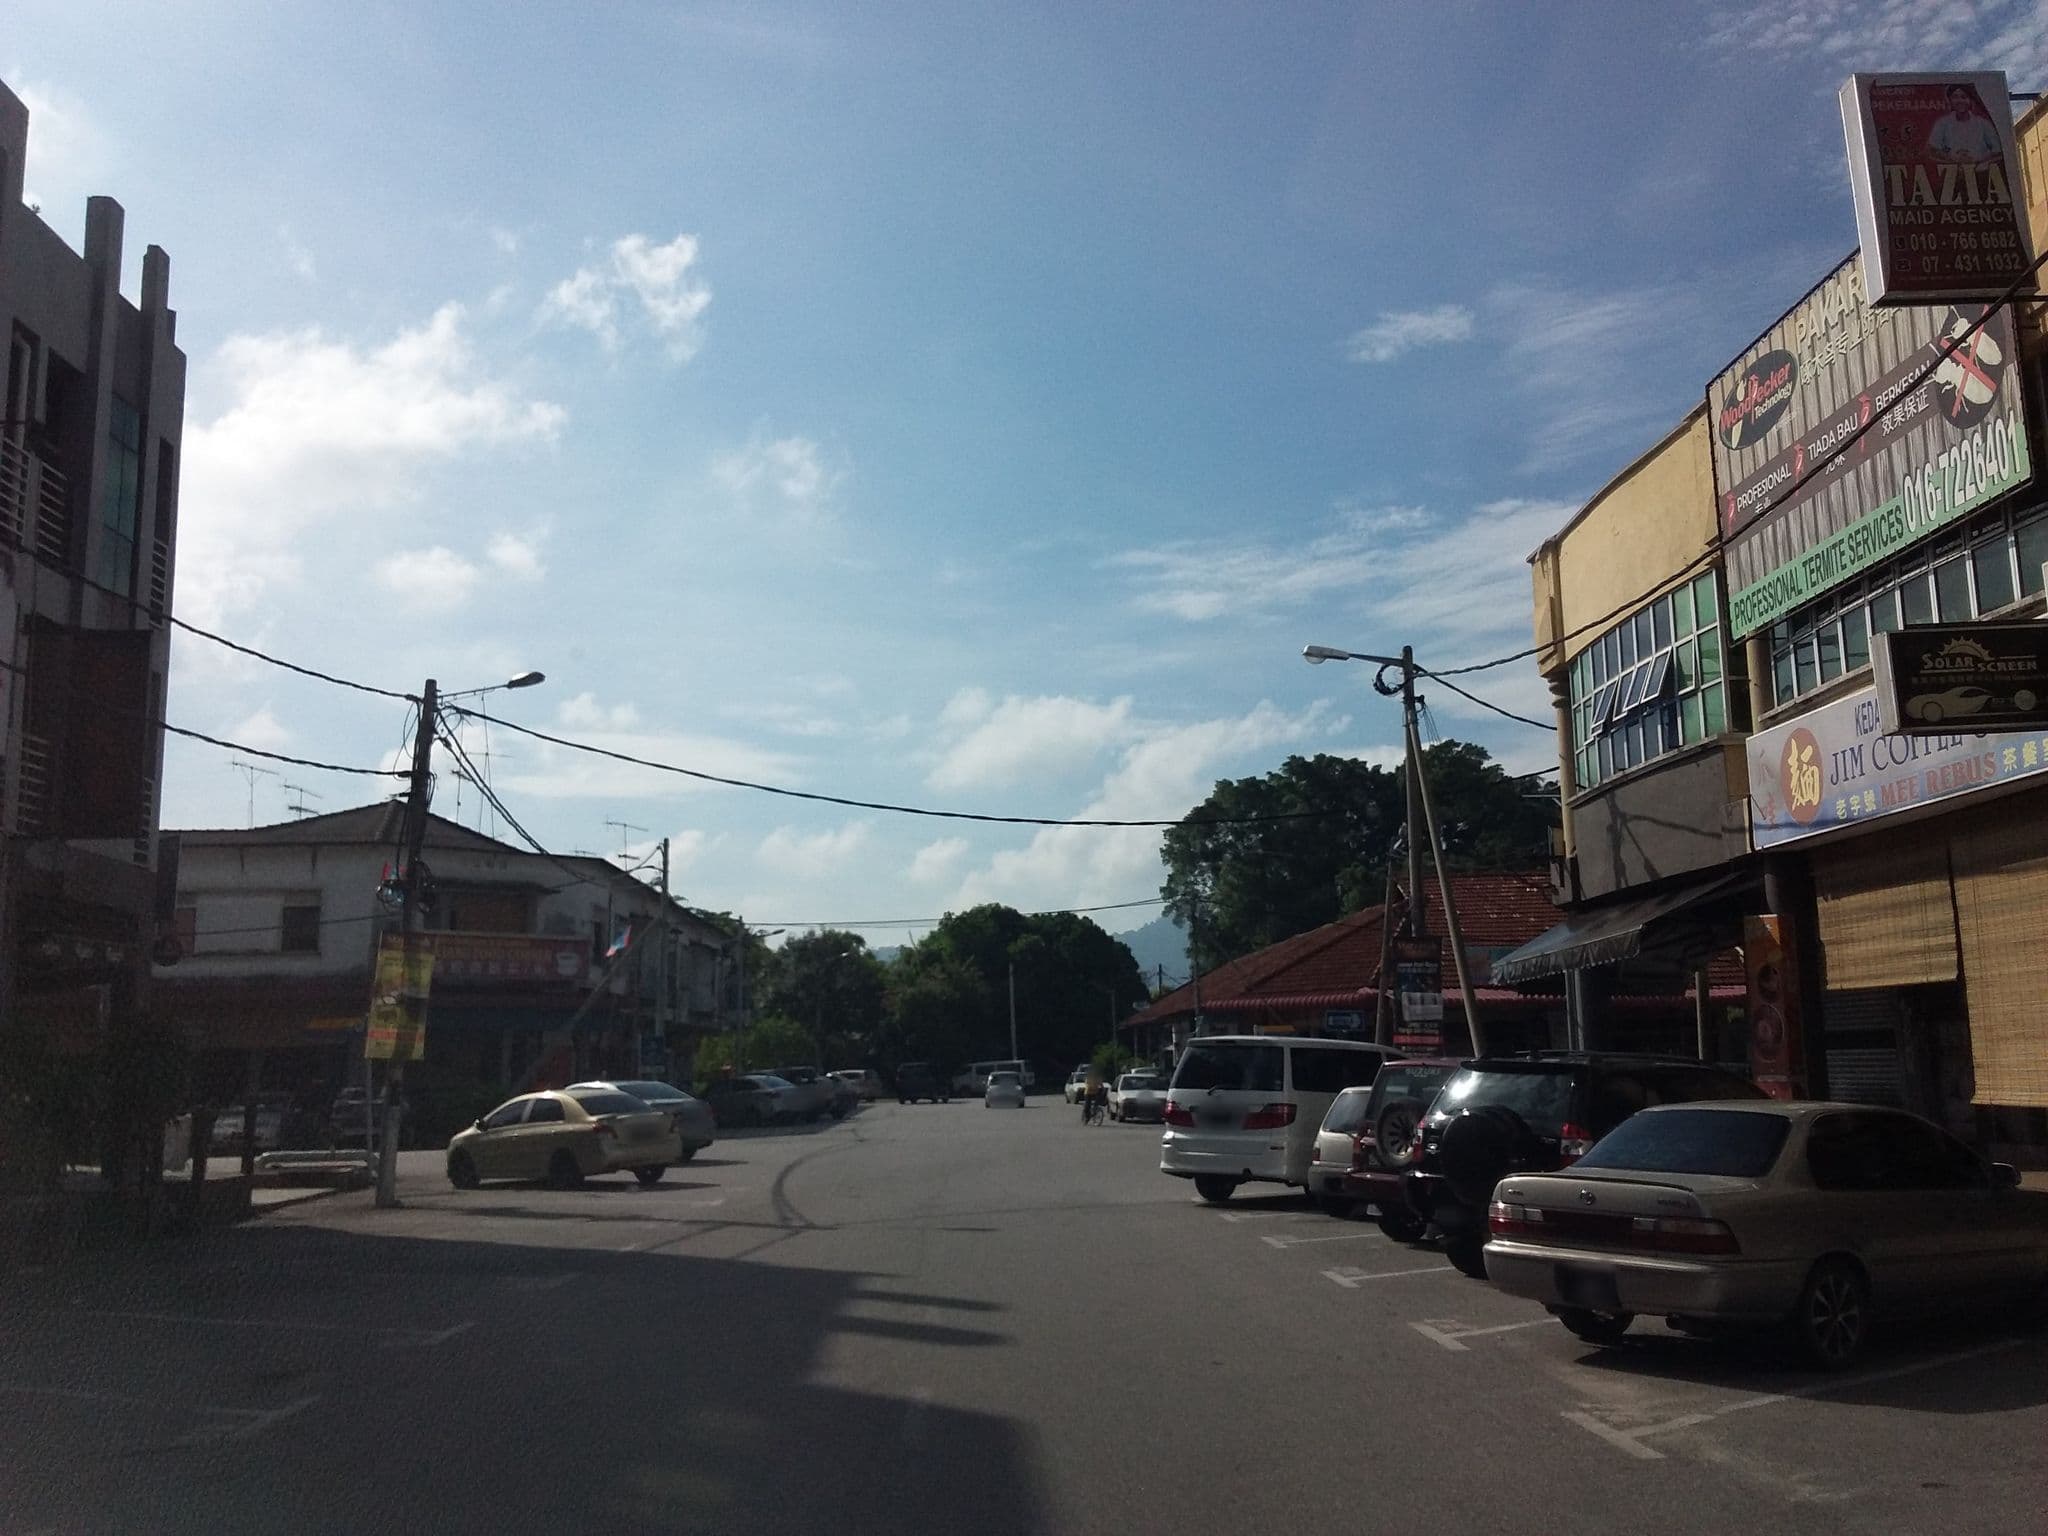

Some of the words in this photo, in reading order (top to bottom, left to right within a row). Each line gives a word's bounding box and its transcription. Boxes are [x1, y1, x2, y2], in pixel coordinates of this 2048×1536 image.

[1884, 163, 2013, 207] TAZIA
[1889, 209, 1934, 225] MAID
[1941, 207, 2014, 225] AGENCY
[1910, 232, 1938, 252] 010
[1950, 231, 1978, 250] 766
[1921, 256, 1939, 273] 07
[1955, 254, 1981, 272] 431
[1985, 253, 2023, 271] 1032
[1795, 270, 1864, 355] PAKAR
[1754, 381, 1793, 420] Technology
[1881, 386, 1930, 436] 效果保证
[1808, 429, 1836, 460] TIADA
[1837, 415, 1859, 442] BAU
[1736, 462, 1792, 512] PROFESIONAL
[1734, 571, 1803, 630] PROFESSIONAL
[1802, 539, 1848, 591] TERMITE
[1847, 504, 1905, 564] SERVICES
[1902, 410, 2021, 533] 016-7226401
[1921, 653, 1975, 669] SOLAR
[1977, 660, 2037, 673] SCREEN
[1830, 744, 1865, 786] JIM
[1880, 775, 1920, 808] MEE
[1925, 751, 1997, 796] REBUS
[1405, 1067, 1440, 1075] SUZUKI
